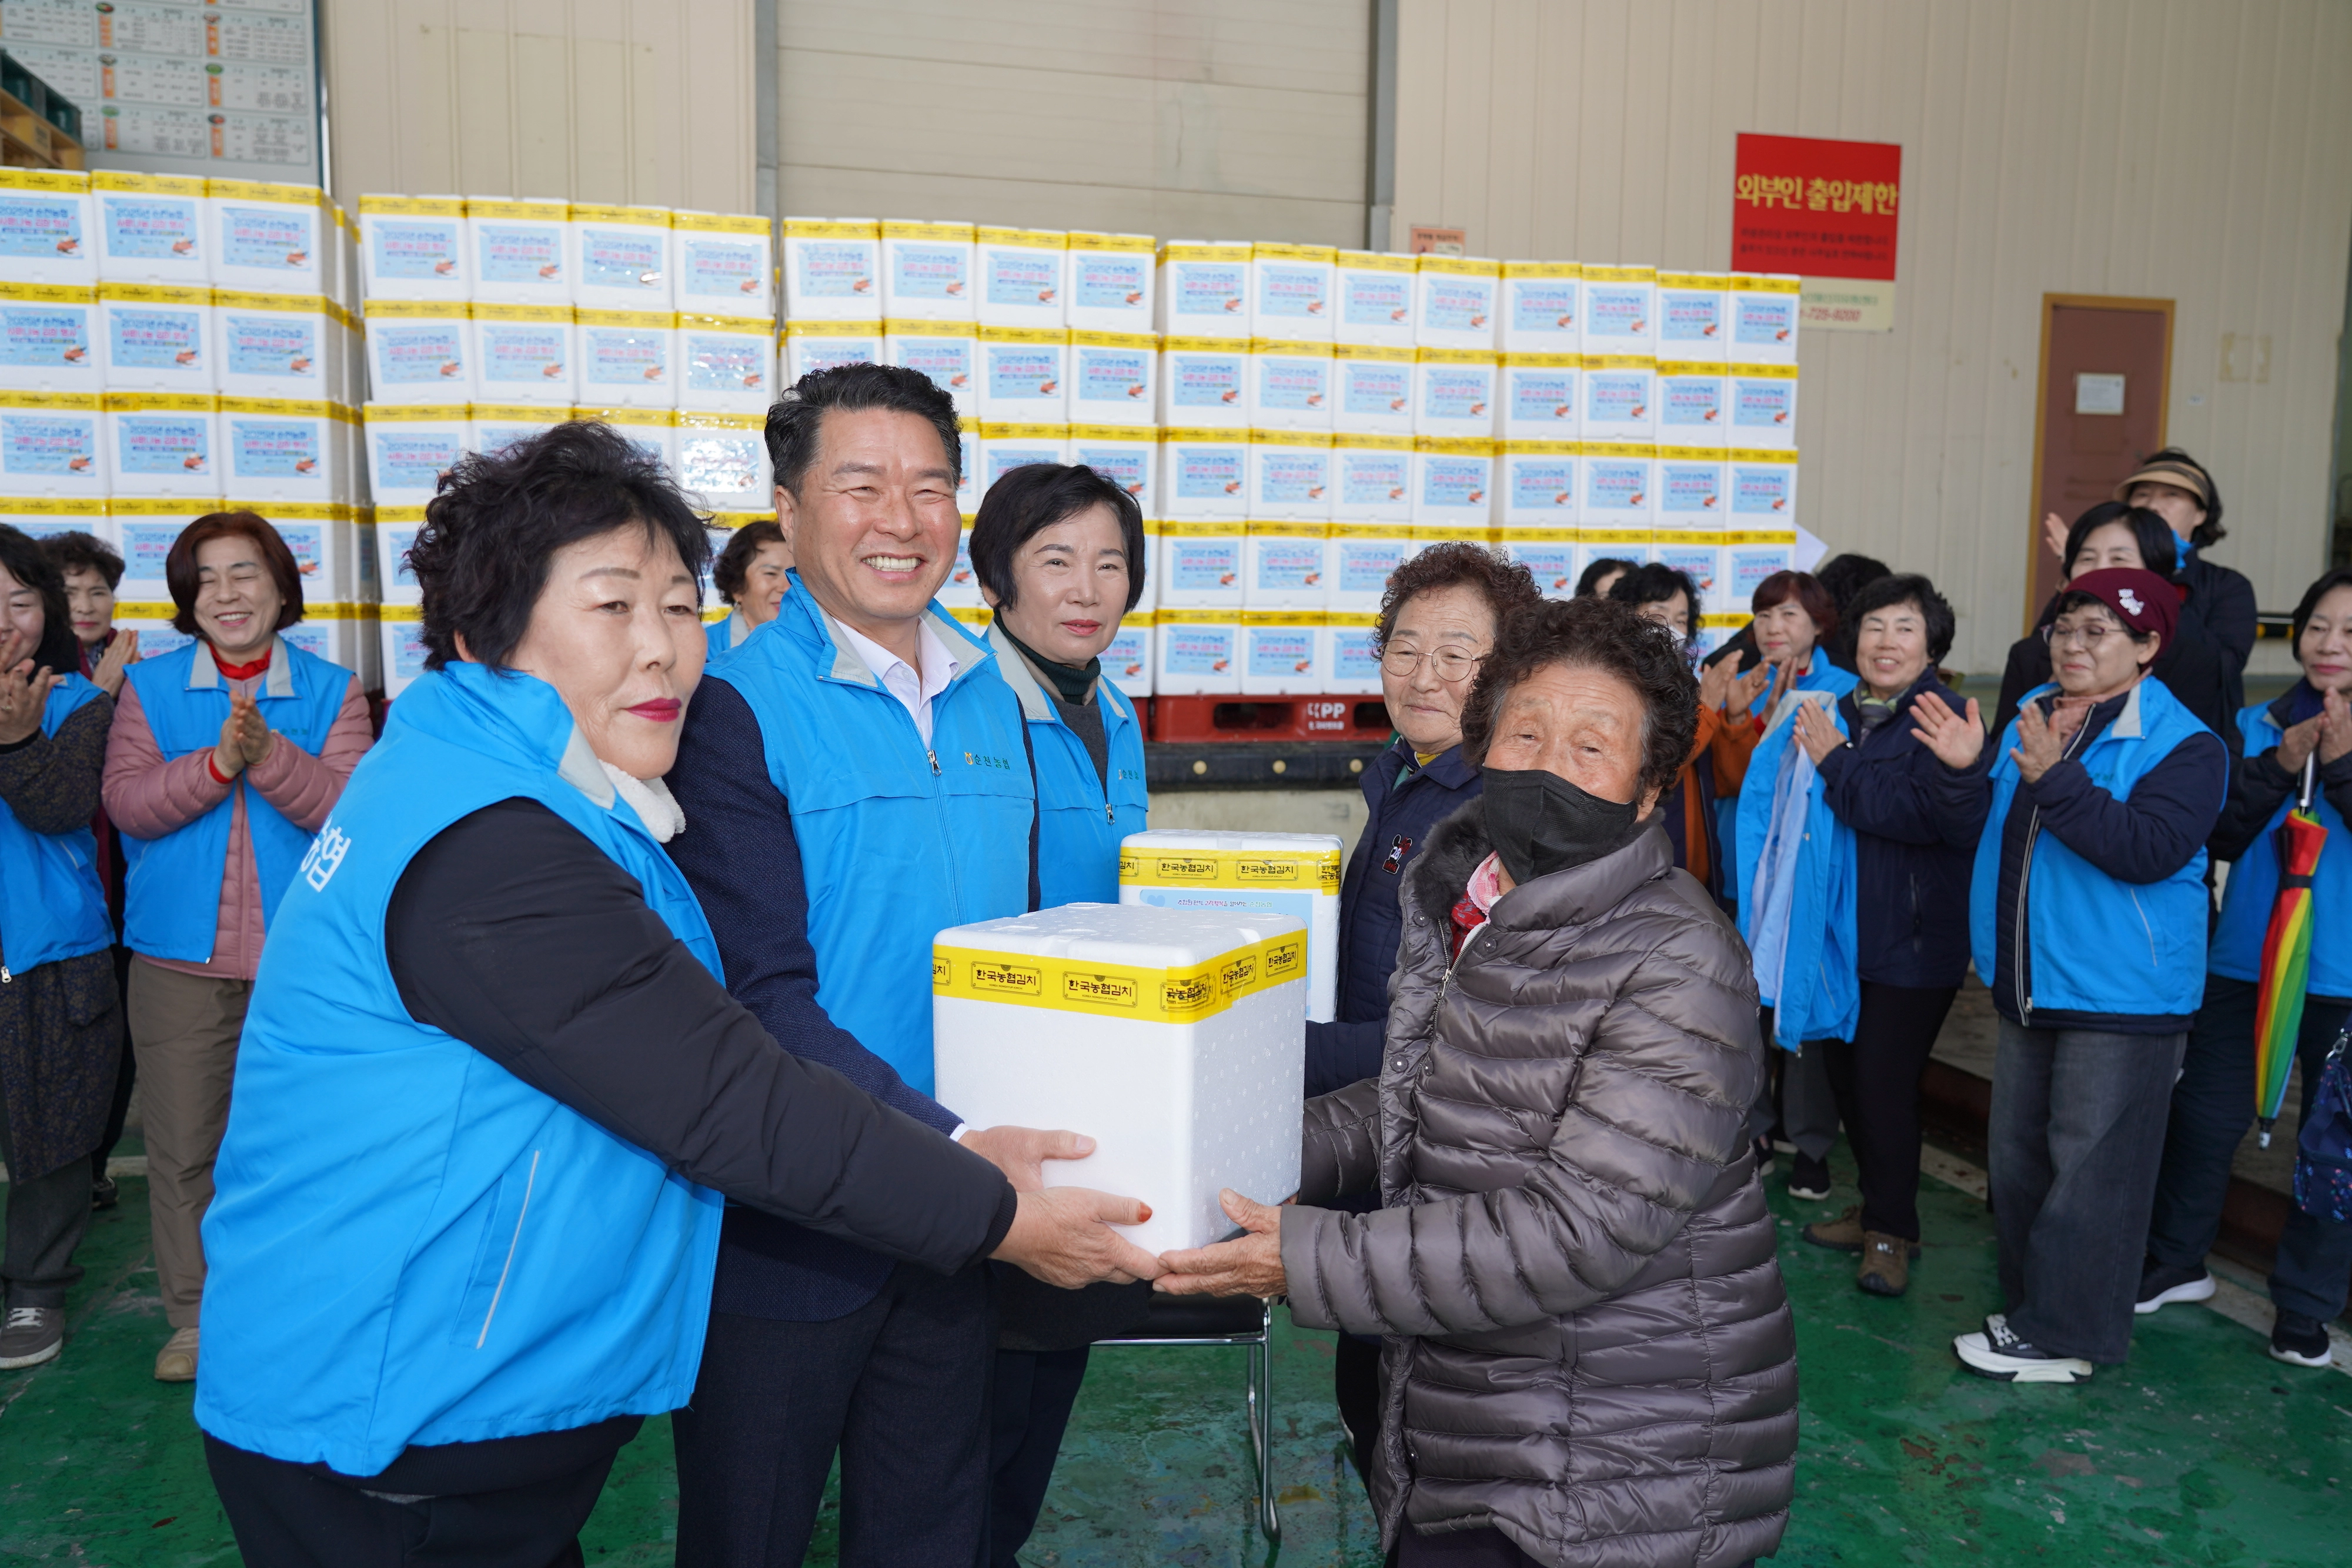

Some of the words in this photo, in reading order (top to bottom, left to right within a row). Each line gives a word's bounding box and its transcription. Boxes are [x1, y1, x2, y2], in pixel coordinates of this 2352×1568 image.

[1735, 173, 1803, 210] 외부인
[1805, 176, 1898, 216] 출입제한
[974, 754, 1010, 770] 순천농협
[1161, 863, 1214, 872] 한국농협김치
[1241, 865, 1294, 874] 한국농협김치
[1268, 950, 1297, 968] 한국농협김치
[976, 969, 1036, 986] 한국농협김치
[1223, 964, 1254, 984] 한국농협김치
[1068, 979, 1131, 997] 한국농협김치
